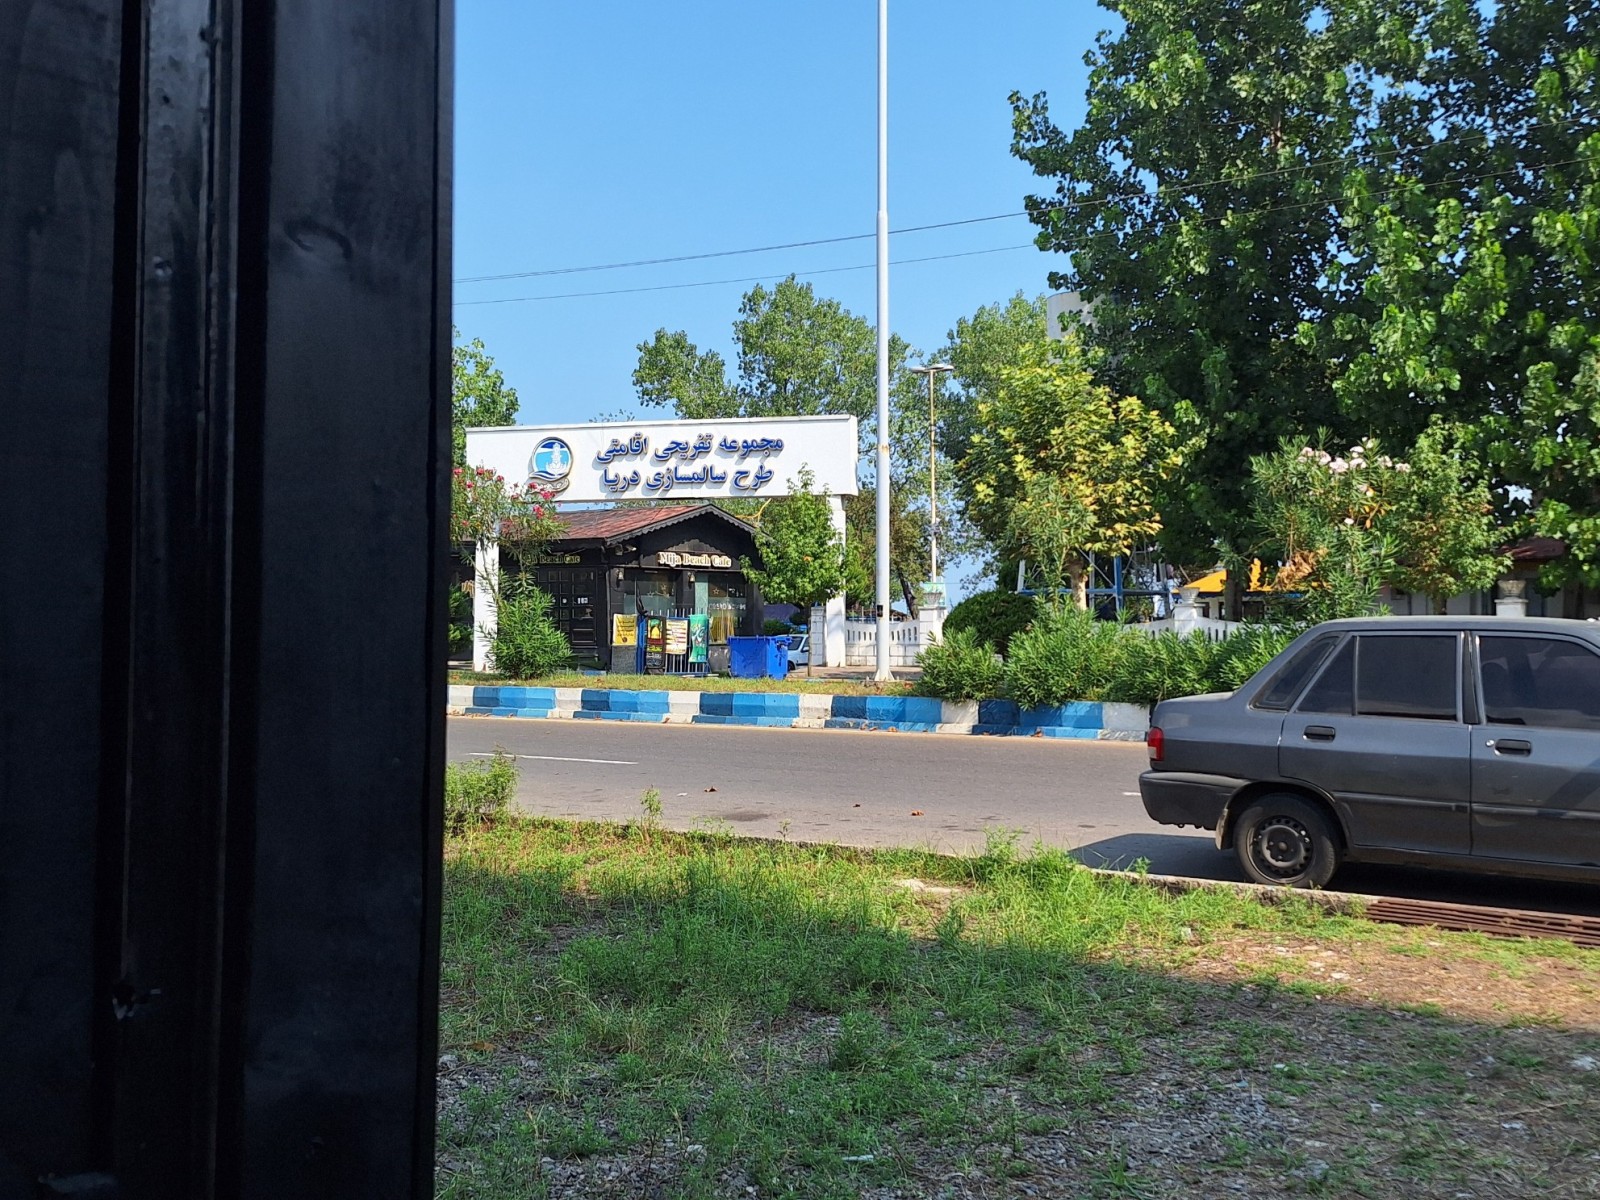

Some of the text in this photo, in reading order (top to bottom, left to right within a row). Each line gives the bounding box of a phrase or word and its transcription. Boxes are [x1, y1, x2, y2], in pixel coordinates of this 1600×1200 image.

[596, 432, 784, 462] مجموعه تفریحی اقامتی
[602, 463, 774, 491] طرح سالمسازی دریا
[658, 552, 732, 567] Mija Beach Cafe
